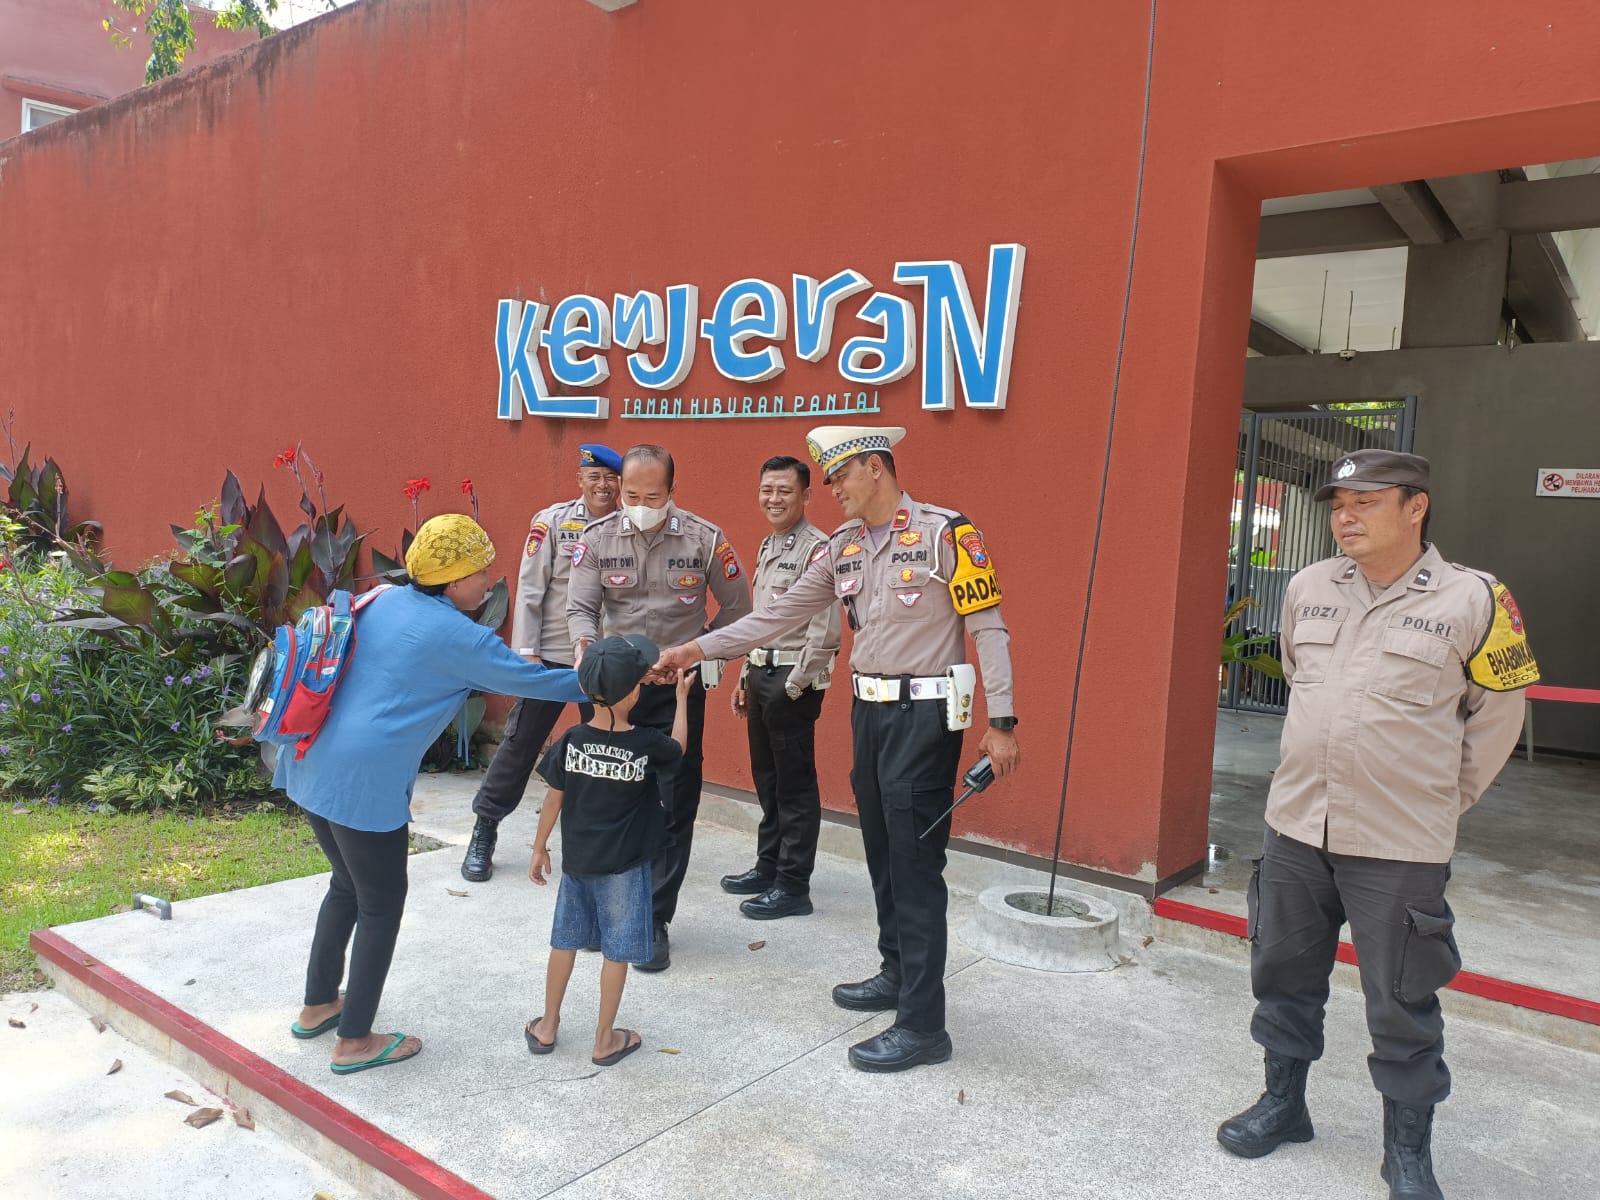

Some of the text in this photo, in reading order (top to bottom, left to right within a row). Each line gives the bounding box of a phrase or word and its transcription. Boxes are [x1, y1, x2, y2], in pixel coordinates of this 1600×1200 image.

[623, 391, 879, 416] TAMAN HIBURAN PANTAI
[891, 549, 928, 564] POLRI
[668, 558, 703, 570] POLRI
[777, 562, 797, 571] POLRI
[1302, 606, 1338, 619] ROZI
[1402, 616, 1452, 639] POLRI
